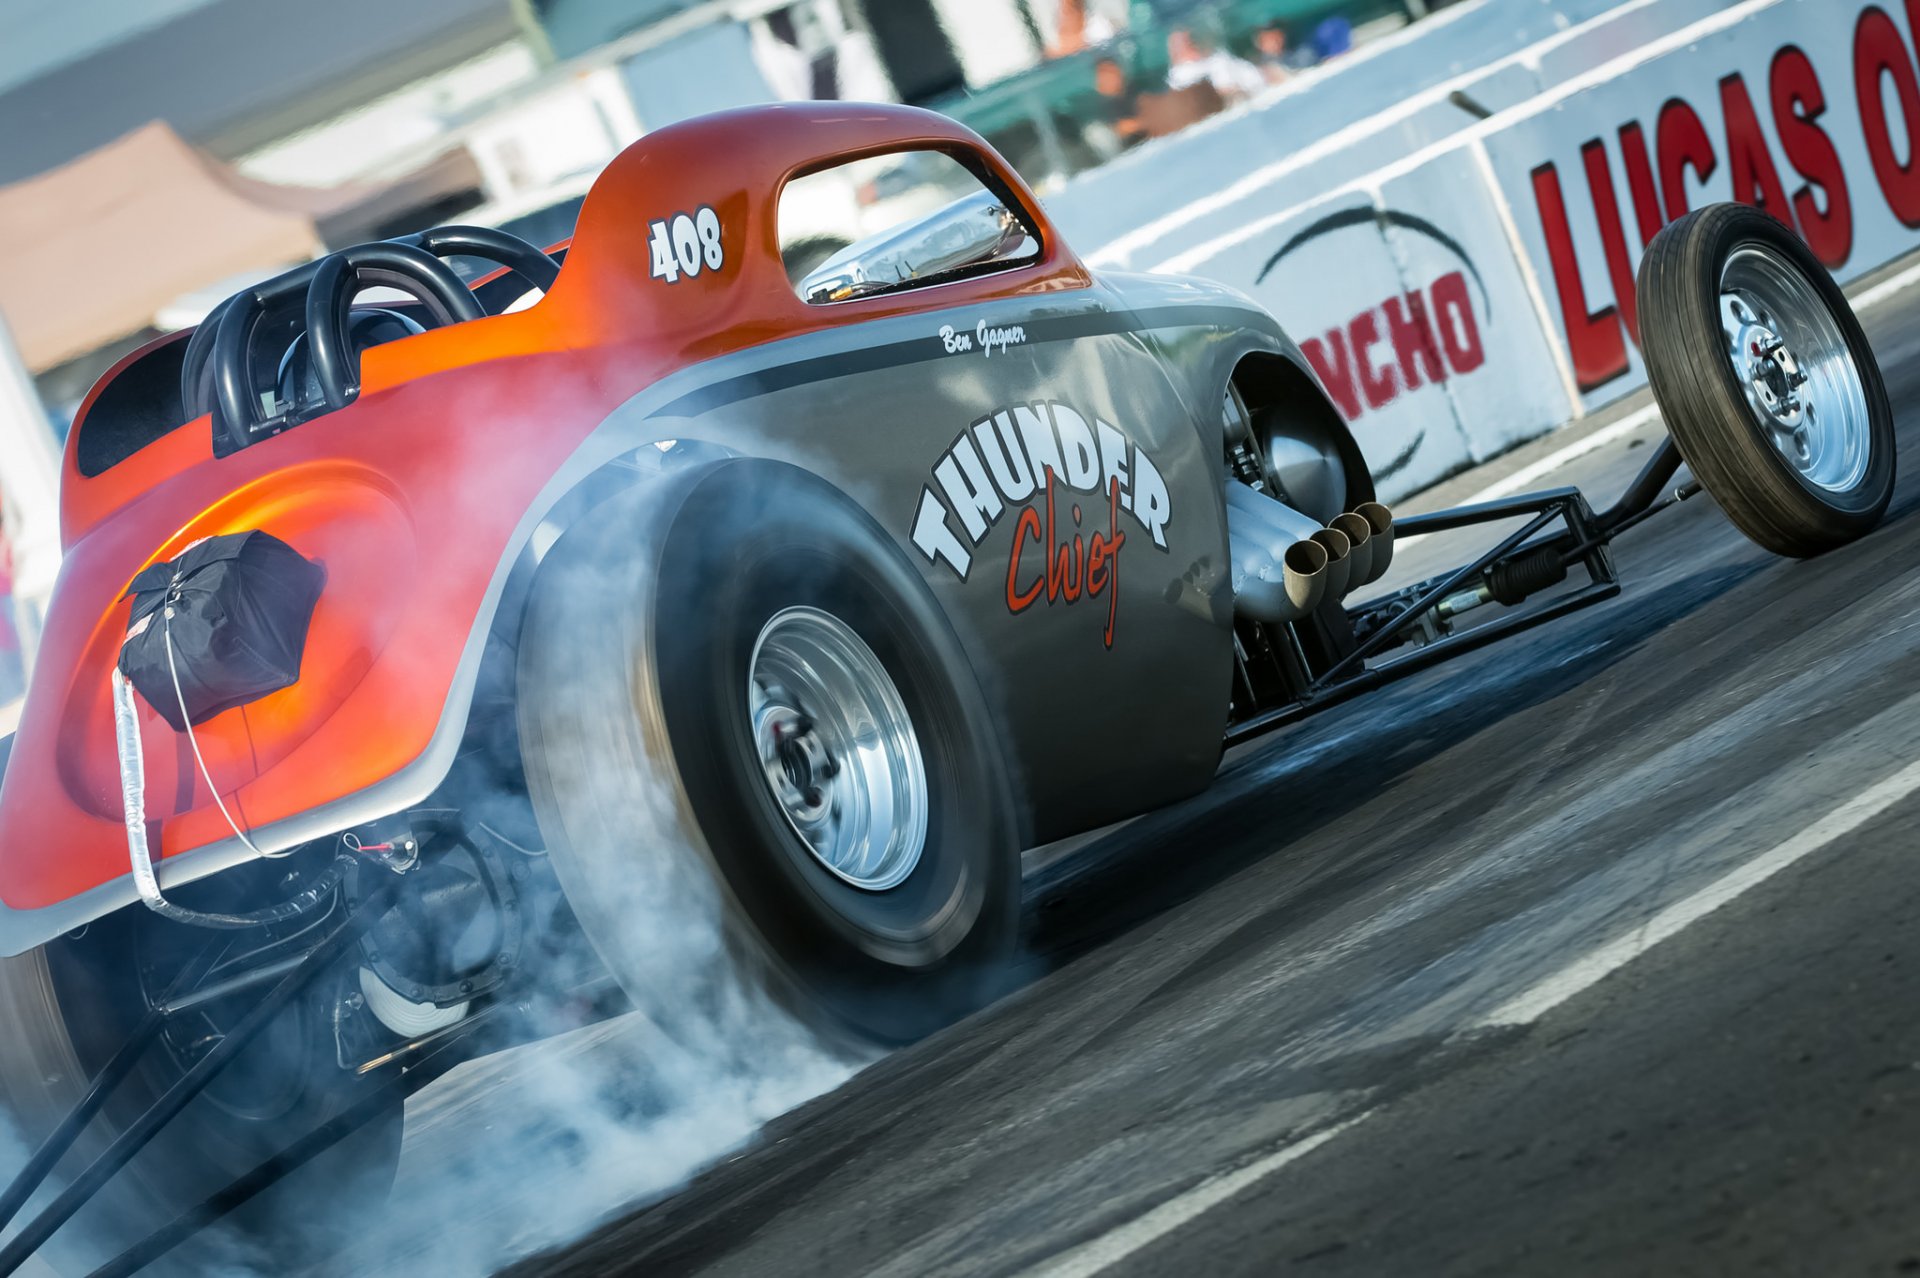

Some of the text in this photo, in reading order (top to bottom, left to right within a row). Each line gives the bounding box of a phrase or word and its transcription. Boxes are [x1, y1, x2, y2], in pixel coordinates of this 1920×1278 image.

[648, 204, 724, 286] 408
[1530, 0, 1920, 394] LUCAS O
[939, 318, 1026, 358] Ben Gagner
[909, 399, 1171, 583] THUNDER
[1005, 464, 1125, 650] Chief
